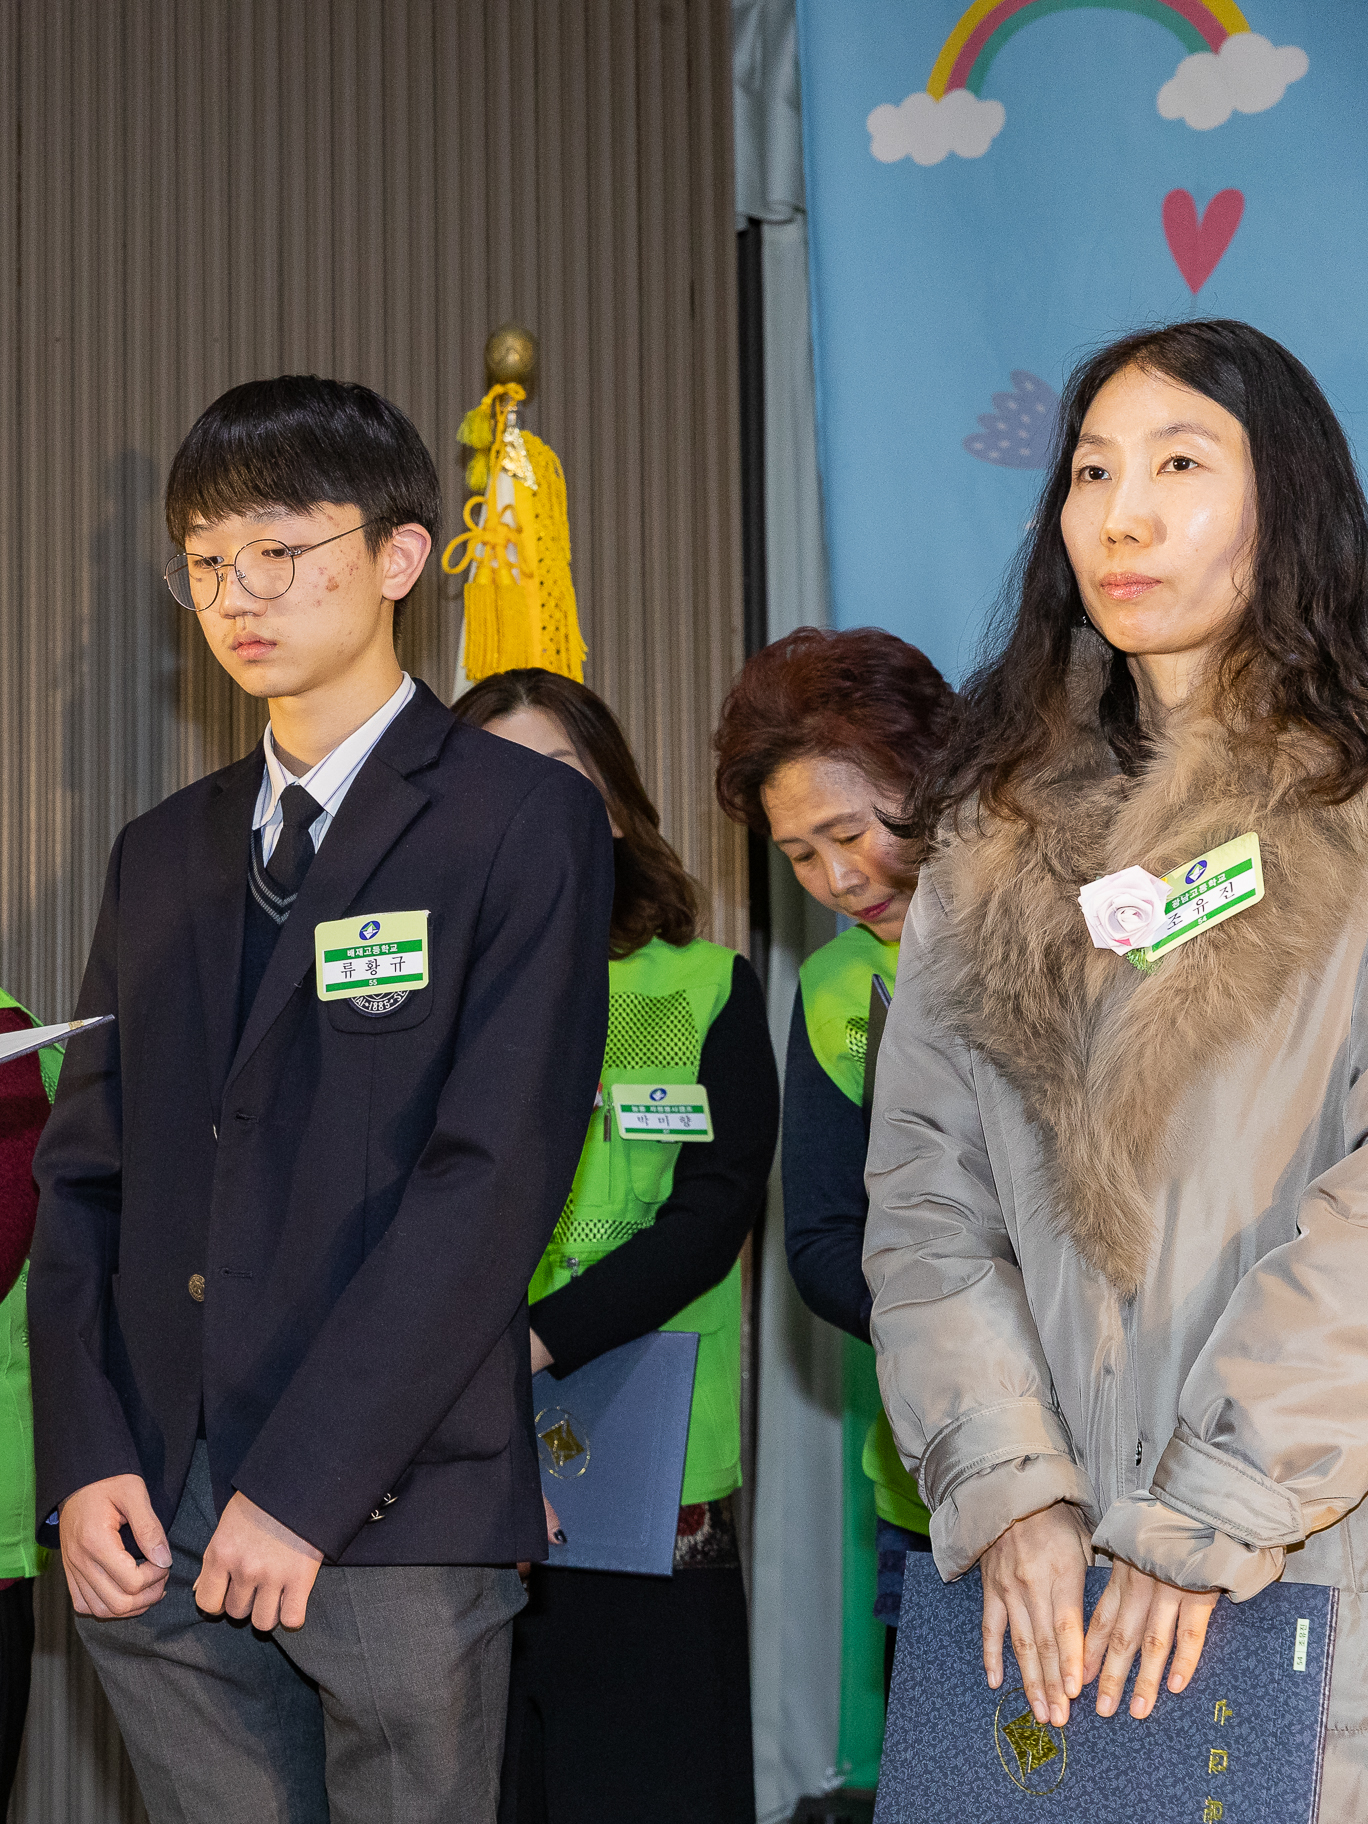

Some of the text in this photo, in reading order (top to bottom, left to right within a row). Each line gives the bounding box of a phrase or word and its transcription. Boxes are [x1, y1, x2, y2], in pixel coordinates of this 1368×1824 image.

[1166, 881, 1235, 931] 조유진
[1197, 915, 1208, 925] 54
[347, 943, 398, 957] 배재고등학교
[340, 956, 406, 979] 류황규
[368, 1000, 390, 1011] 1885
